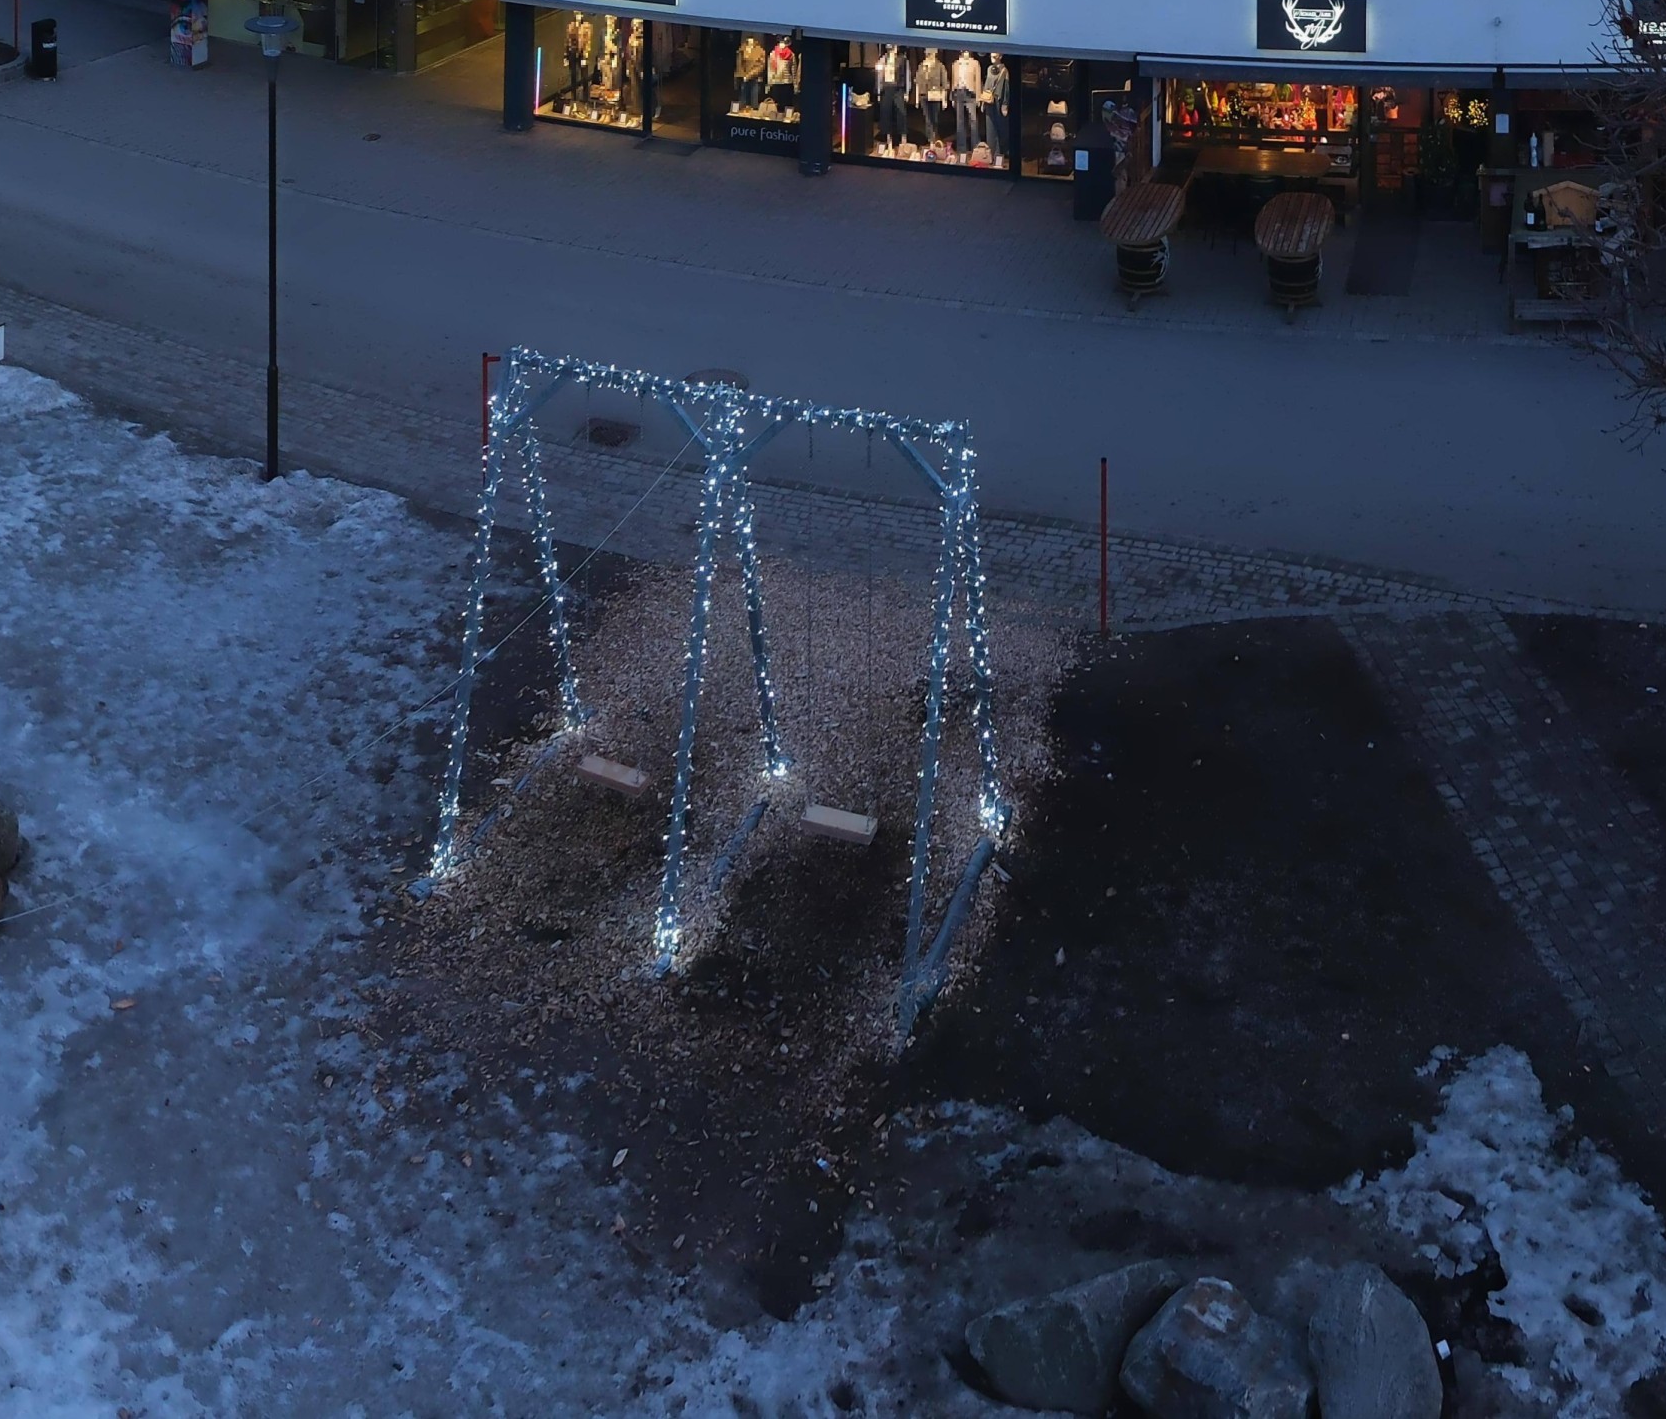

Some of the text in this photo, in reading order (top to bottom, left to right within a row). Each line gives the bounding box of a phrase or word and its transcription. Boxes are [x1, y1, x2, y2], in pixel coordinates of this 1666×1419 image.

[915, 19, 945, 28] SEEFELD
[946, 21, 982, 31] SHOPPING
[730, 126, 757, 138] pure
